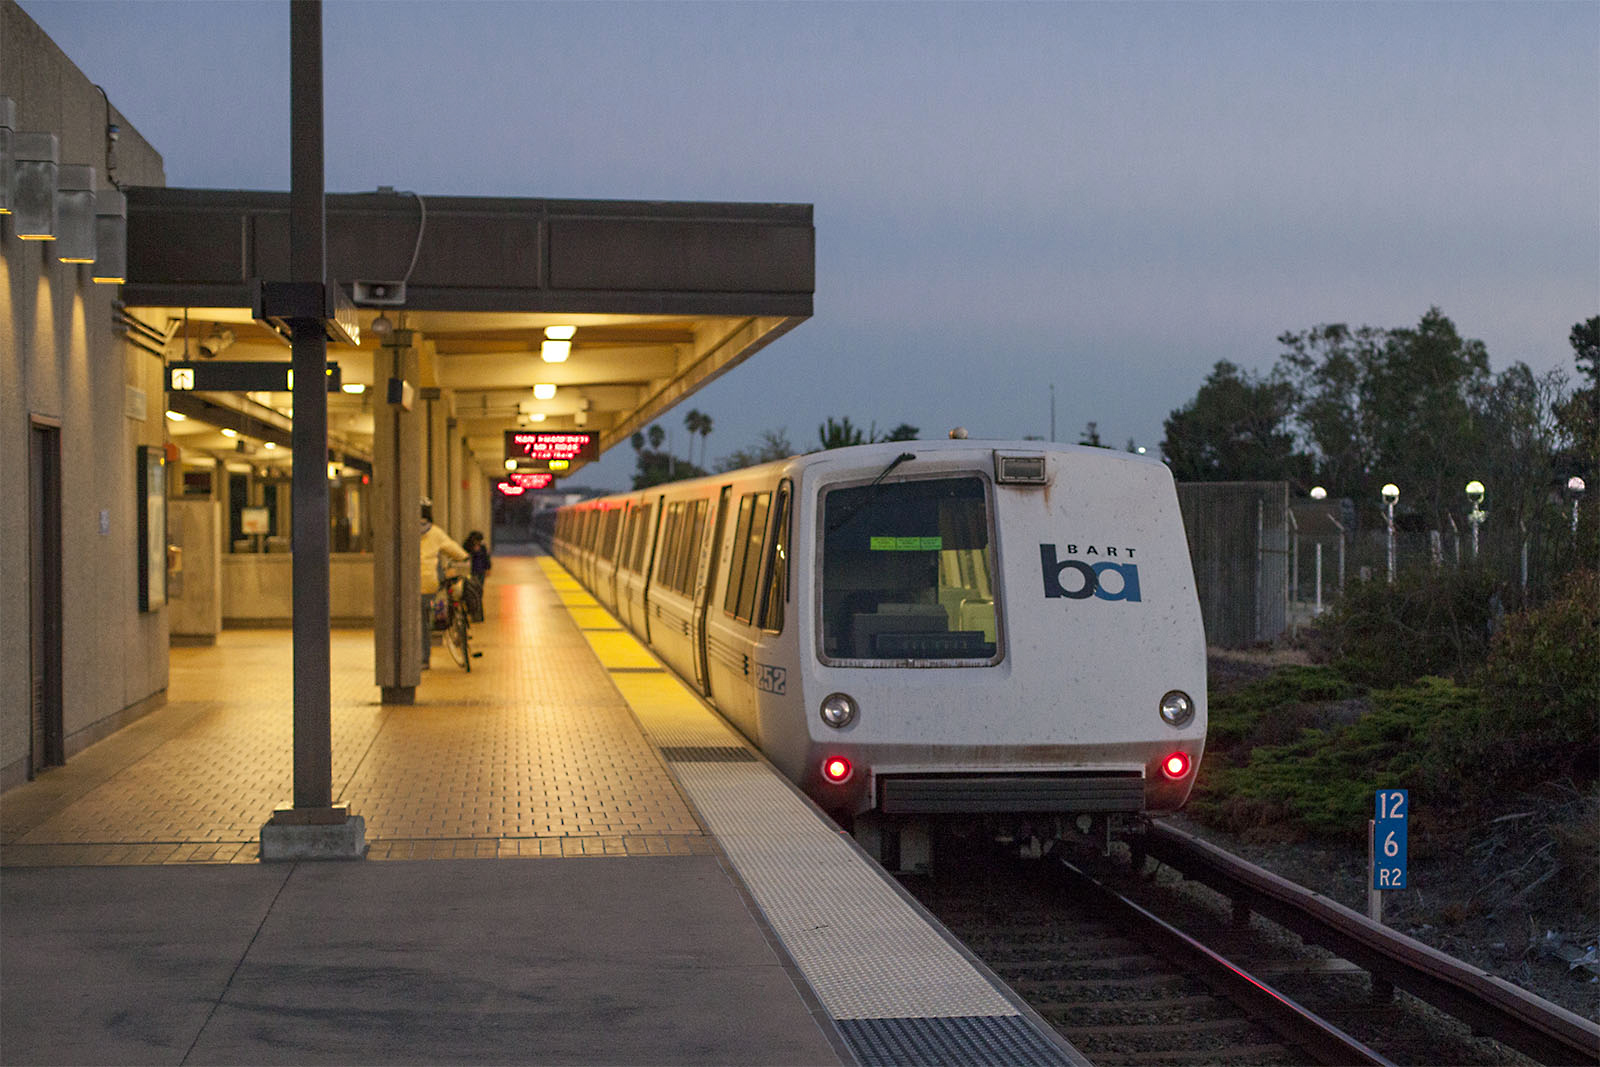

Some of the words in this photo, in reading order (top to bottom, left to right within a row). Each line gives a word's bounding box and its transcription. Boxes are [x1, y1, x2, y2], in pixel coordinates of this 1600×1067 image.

[1067, 543, 1137, 559] BART
[1380, 791, 1405, 819] 12
[1383, 830, 1399, 857] 6
[1380, 867, 1402, 887] R2
